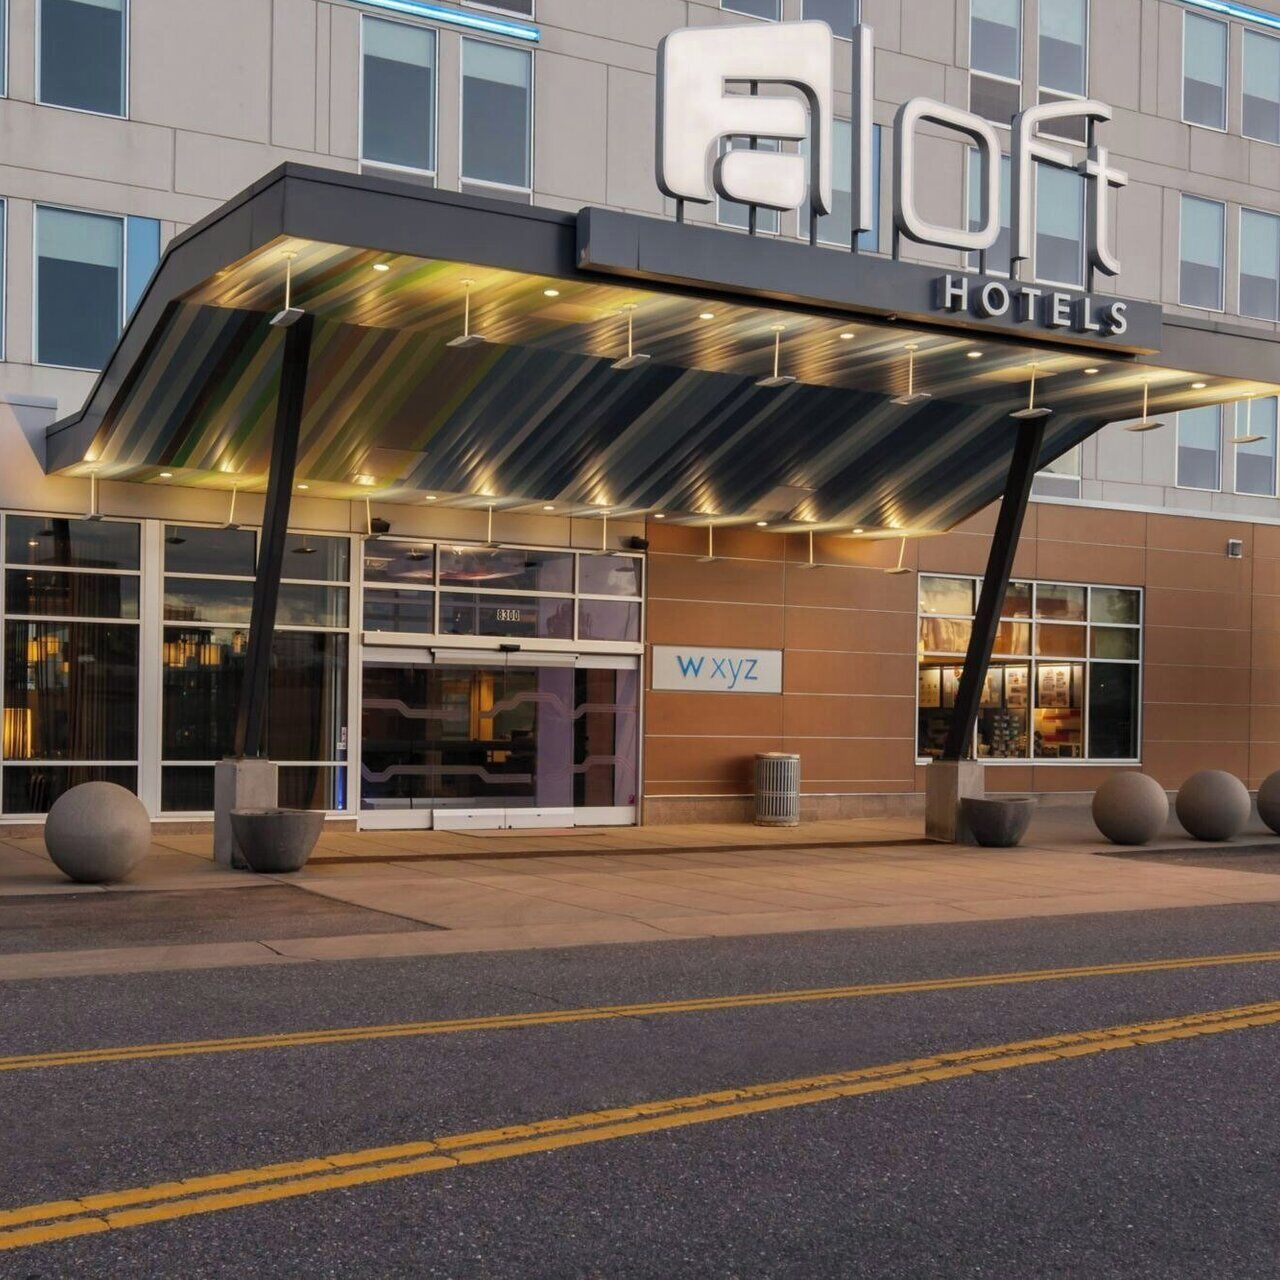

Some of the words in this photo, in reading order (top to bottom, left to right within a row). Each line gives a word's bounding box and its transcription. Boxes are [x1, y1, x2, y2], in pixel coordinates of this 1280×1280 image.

[656, 20, 1128, 277] aloft
[939, 273, 1128, 336] HOTELS
[496, 609, 520, 621] 8300
